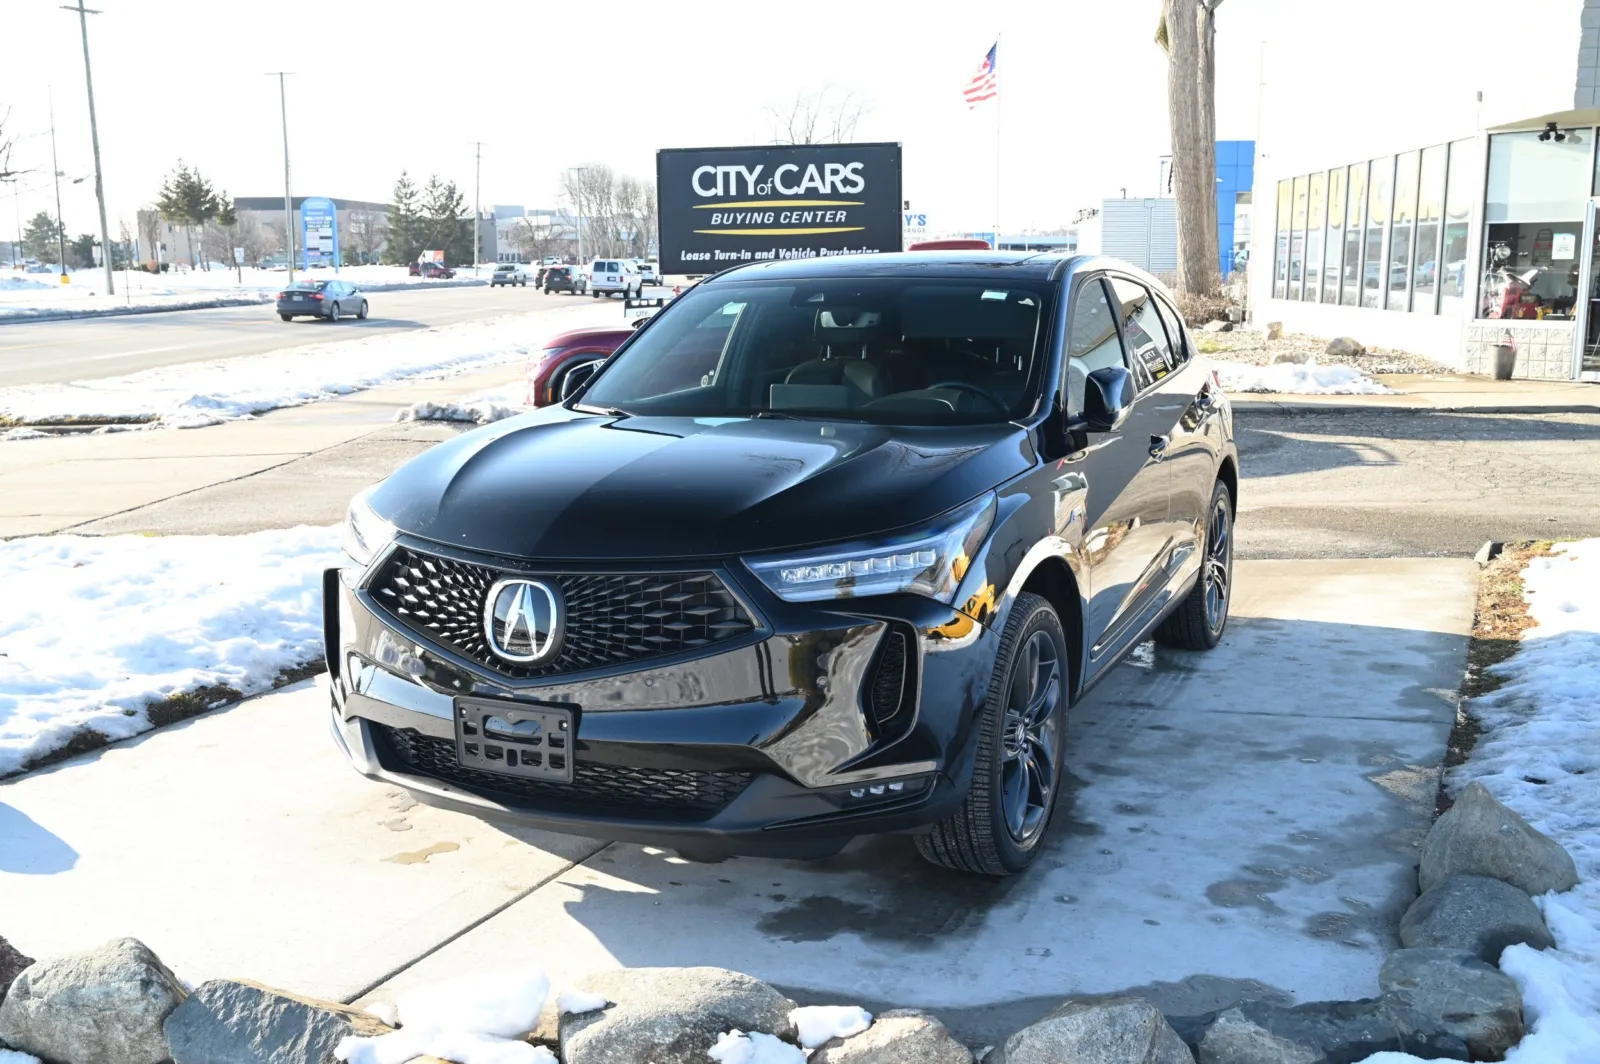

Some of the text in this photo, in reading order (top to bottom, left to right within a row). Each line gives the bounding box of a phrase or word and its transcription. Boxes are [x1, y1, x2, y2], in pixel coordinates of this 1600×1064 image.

[692, 162, 865, 197] CITY of CARS
[711, 210, 847, 225] BUYING CENTER
[904, 214, 927, 226] Y'S
[681, 250, 711, 261] Lease
[714, 249, 752, 261] Turn-In
[755, 248, 775, 260] and
[779, 247, 816, 259] Vehicle
